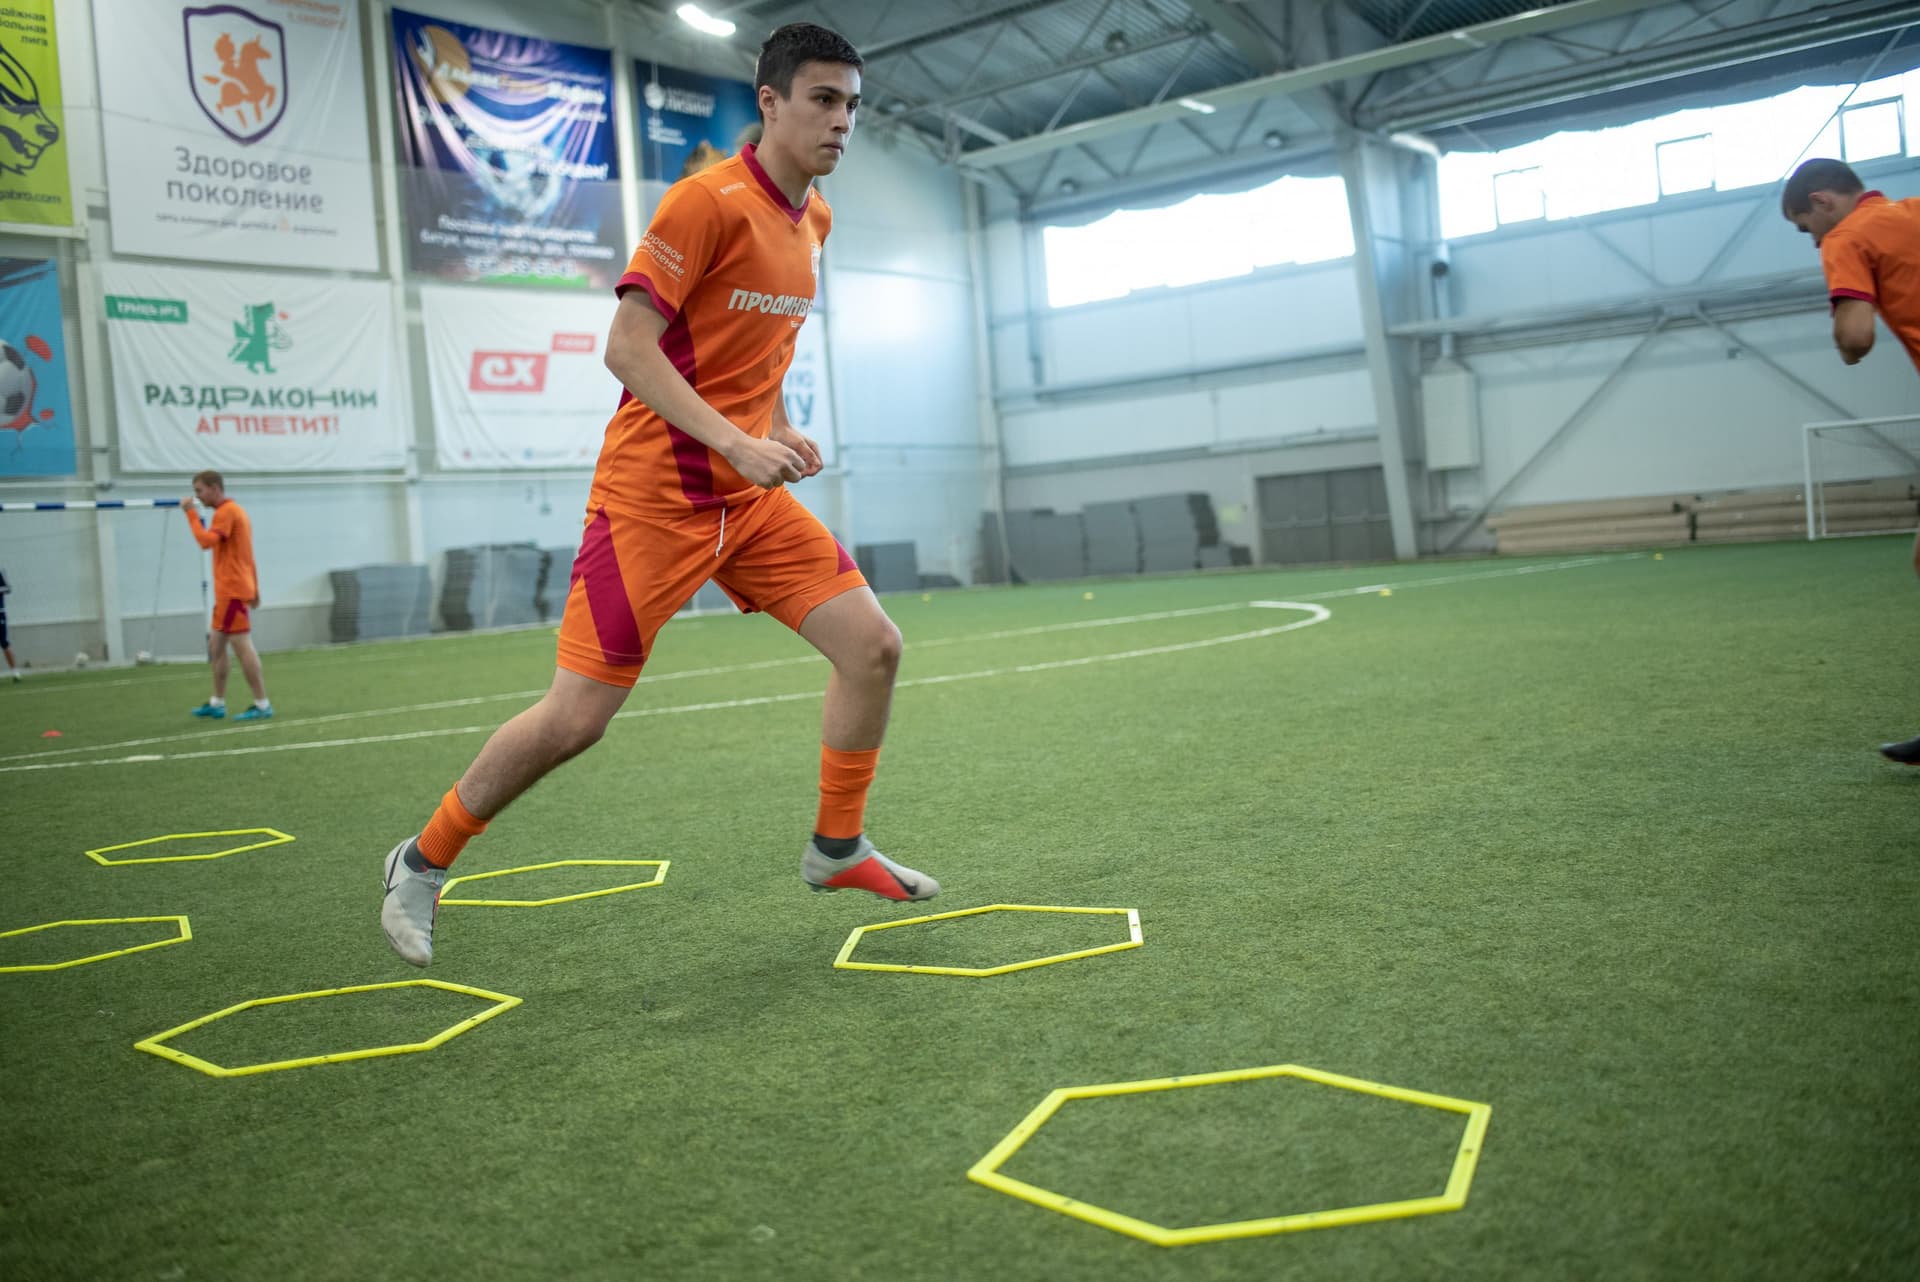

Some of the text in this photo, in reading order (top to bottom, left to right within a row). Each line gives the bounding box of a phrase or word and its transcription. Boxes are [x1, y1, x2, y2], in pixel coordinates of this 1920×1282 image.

[174, 146, 312, 185] Здоровое
[166, 180, 324, 214] поколение
[144, 384, 378, 410] РАЗДРАКОНИМ
[196, 414, 340, 436] АППЕТИТ!
